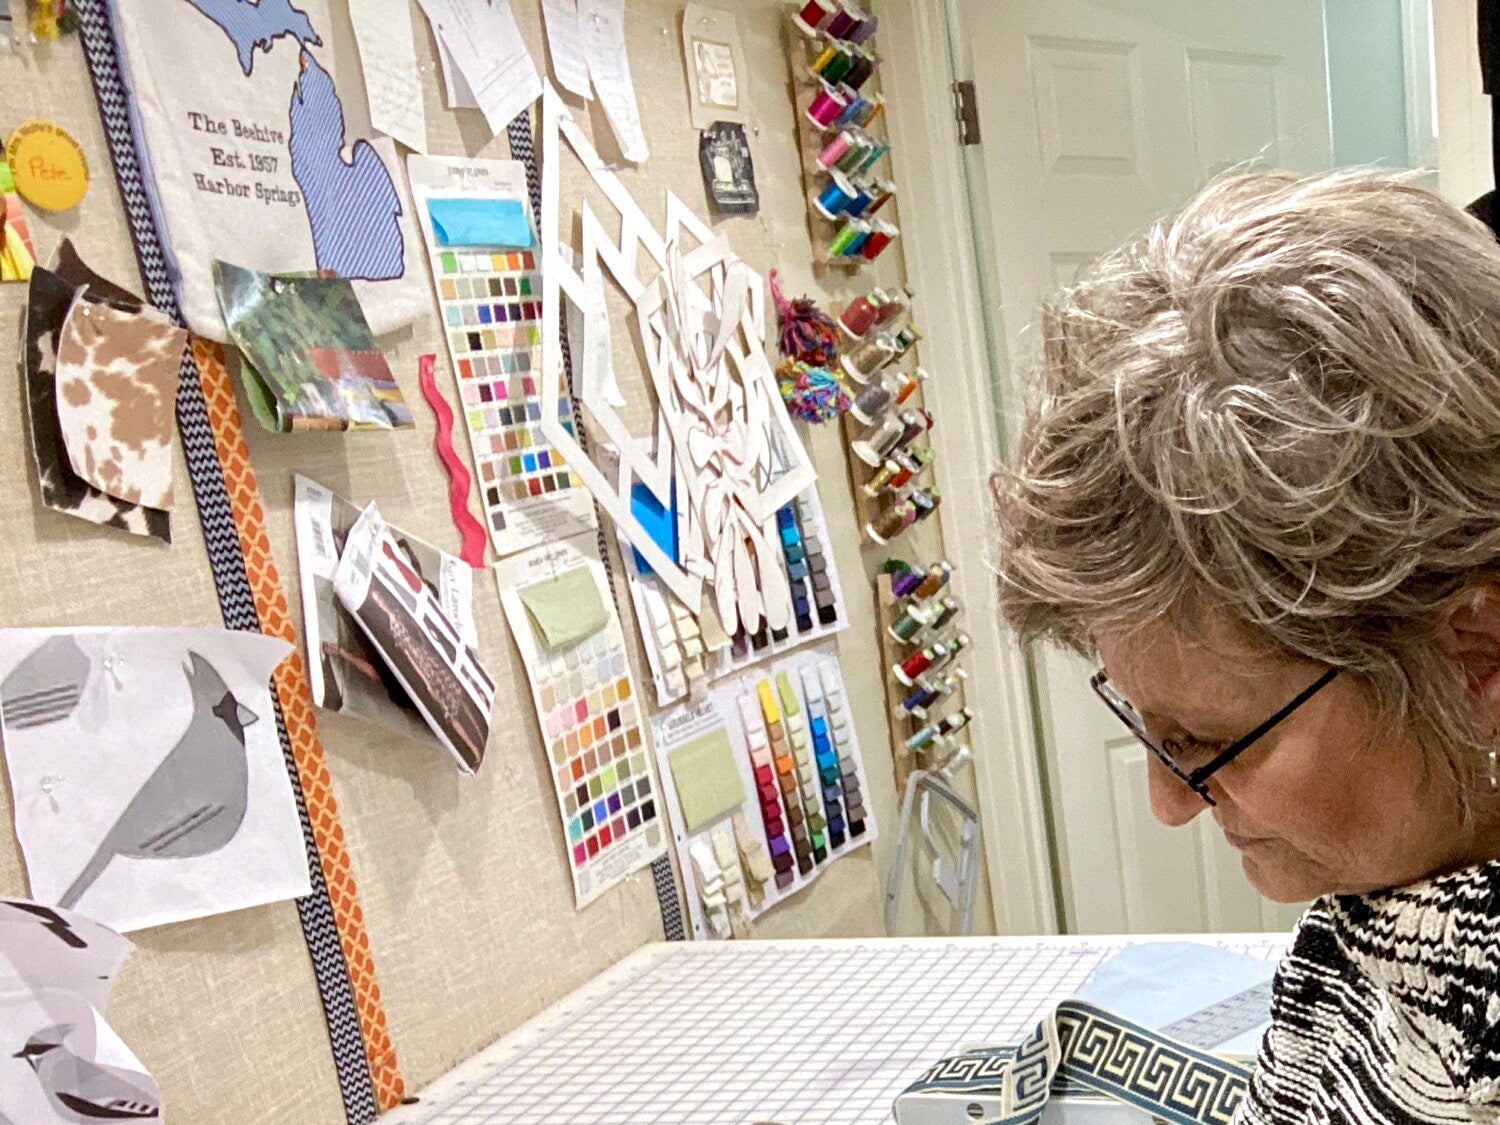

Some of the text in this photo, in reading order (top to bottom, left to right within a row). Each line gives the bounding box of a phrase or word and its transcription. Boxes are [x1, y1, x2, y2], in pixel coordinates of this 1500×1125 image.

[187, 111, 284, 145] The Beehive
[28, 155, 72, 181] Pete
[209, 146, 278, 174] Est. 1957
[192, 172, 301, 208] Harbor Springs
